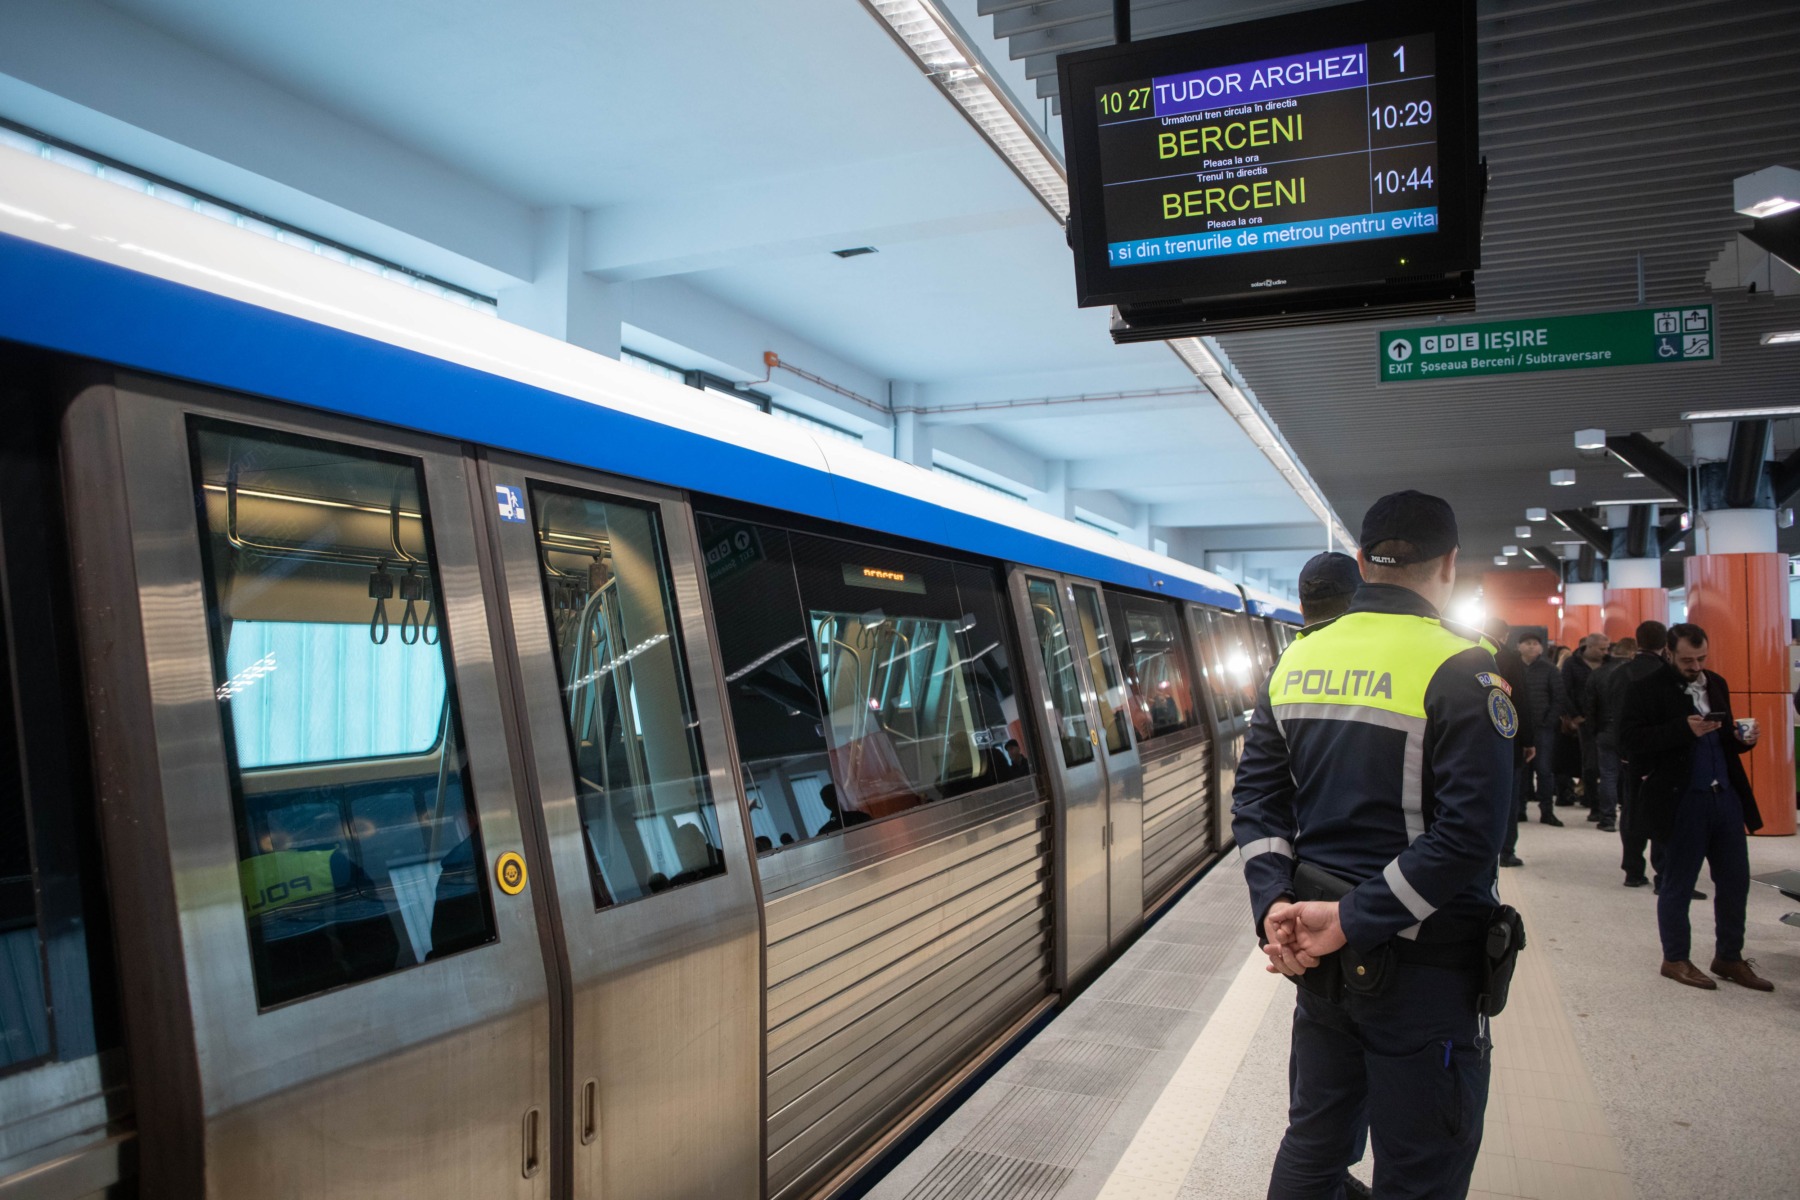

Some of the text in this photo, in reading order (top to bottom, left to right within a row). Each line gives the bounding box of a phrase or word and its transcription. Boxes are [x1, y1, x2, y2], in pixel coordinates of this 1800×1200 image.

[1392, 46, 1406, 73] 1
[1155, 53, 1364, 104] TUDOR ARGHEZI
[1100, 87, 1151, 115] 10 27
[1162, 98, 1297, 126] Urmatorul tren circula în directia
[1371, 100, 1433, 131] 10:29
[1158, 114, 1303, 160] BERCENI
[1196, 166, 1268, 183] Trenul în directia
[1203, 155, 1260, 169] Pleaca la ora
[1374, 166, 1434, 195] 10:44
[1162, 177, 1306, 220] BERCENI
[1207, 216, 1263, 230] Pleaca la ora
[1119, 244, 1132, 260] si
[1136, 242, 1161, 258] din
[1165, 233, 1232, 255] trenurile
[1237, 231, 1259, 247] de
[1263, 225, 1323, 244] metrou
[1329, 217, 1386, 241] pentru
[1424, 339, 1435, 351] C
[1445, 337, 1455, 349] D
[1465, 335, 1474, 347] E
[1388, 362, 1413, 375] EXIT
[1471, 355, 1515, 369] Berceni
[1517, 353, 1523, 366] /
[1525, 350, 1612, 365] Subtraversare
[1283, 669, 1393, 700] POLITIA
